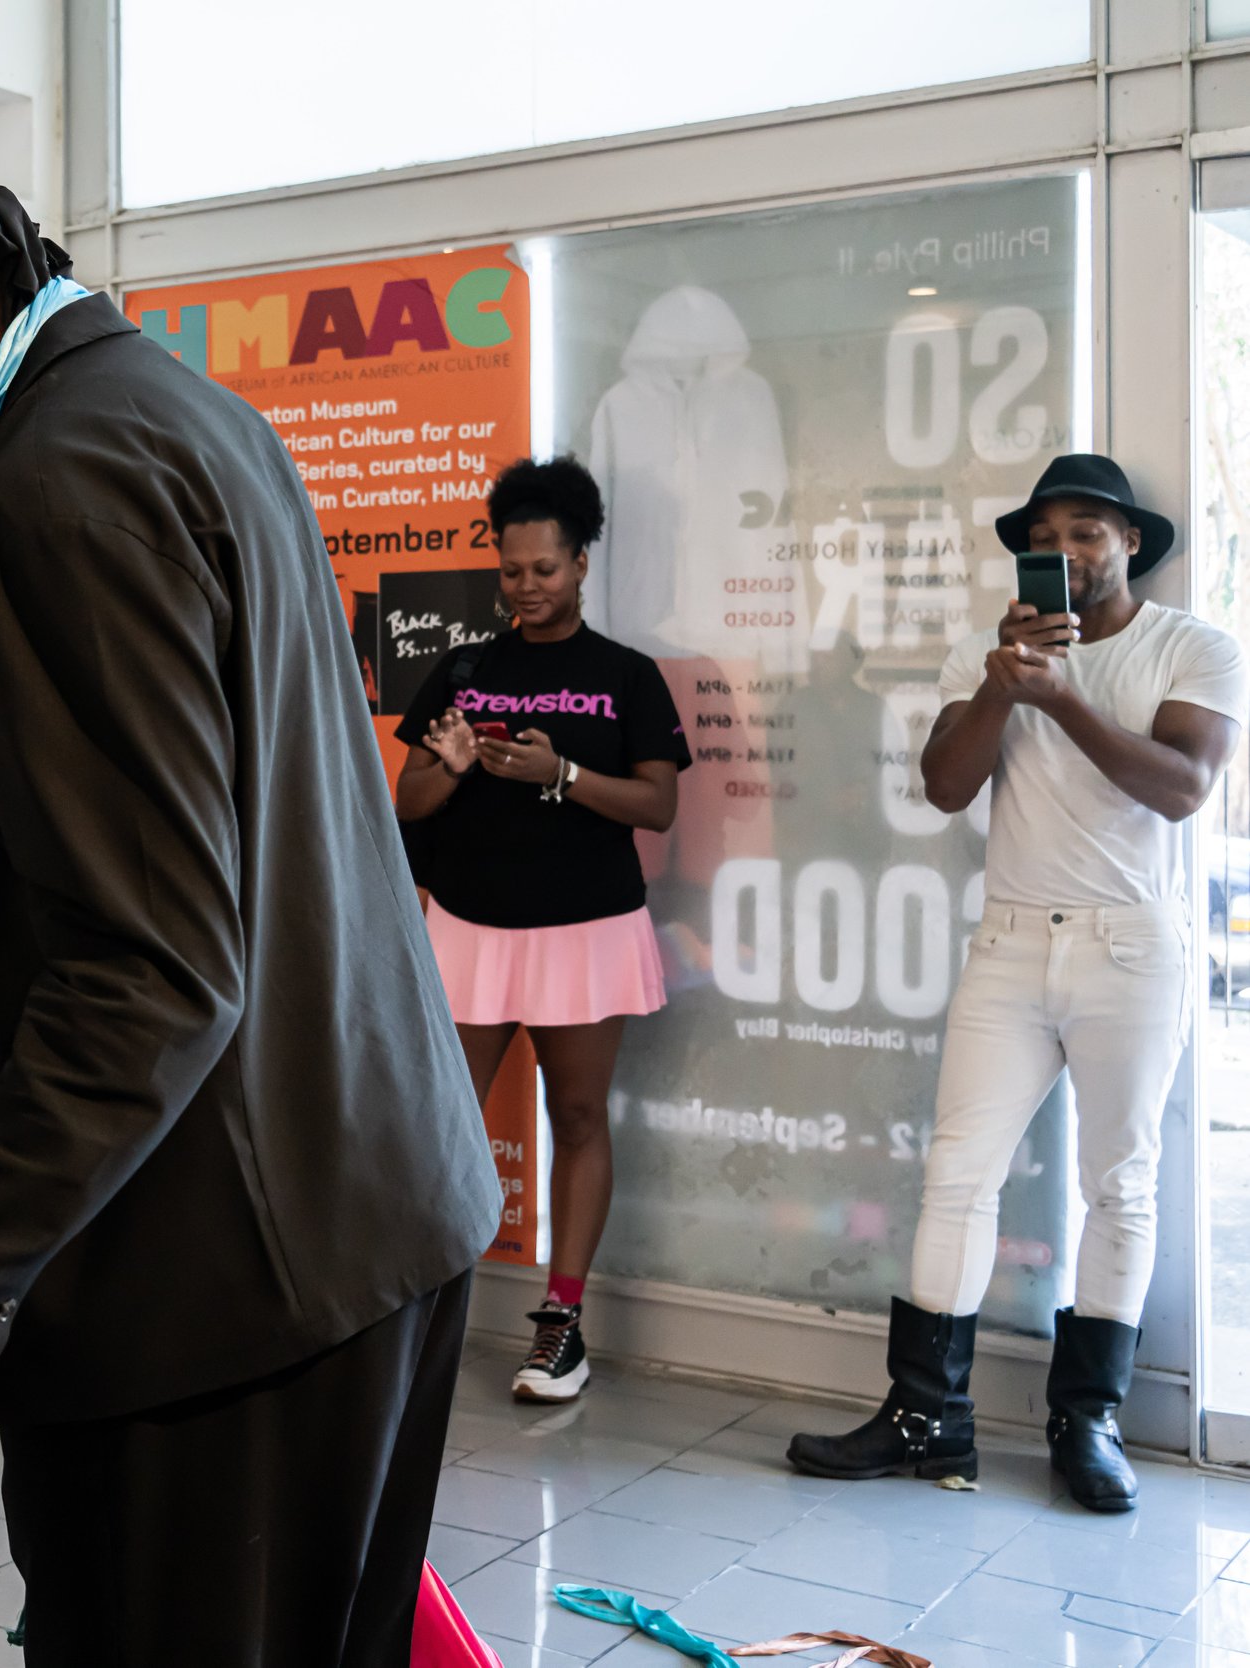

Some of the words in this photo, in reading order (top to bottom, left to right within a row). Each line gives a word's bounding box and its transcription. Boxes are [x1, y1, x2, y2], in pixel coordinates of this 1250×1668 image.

[141, 267, 513, 377] HMAAC
[272, 375, 286, 389] of
[290, 368, 354, 385] AFRICAN
[358, 358, 438, 380] AMERICAN
[444, 353, 510, 373] CULTURE
[263, 405, 306, 424] ston
[310, 399, 398, 422] Museum
[338, 426, 415, 449] Culture
[421, 421, 453, 442] for
[458, 421, 496, 439] our
[297, 460, 365, 481] Series,
[369, 451, 451, 475] curated
[458, 450, 486, 474] by
[343, 485, 427, 508] Curator,
[432, 479, 494, 503] HMAA
[325, 523, 460, 557] ptember
[386, 609, 443, 639] BLACK
